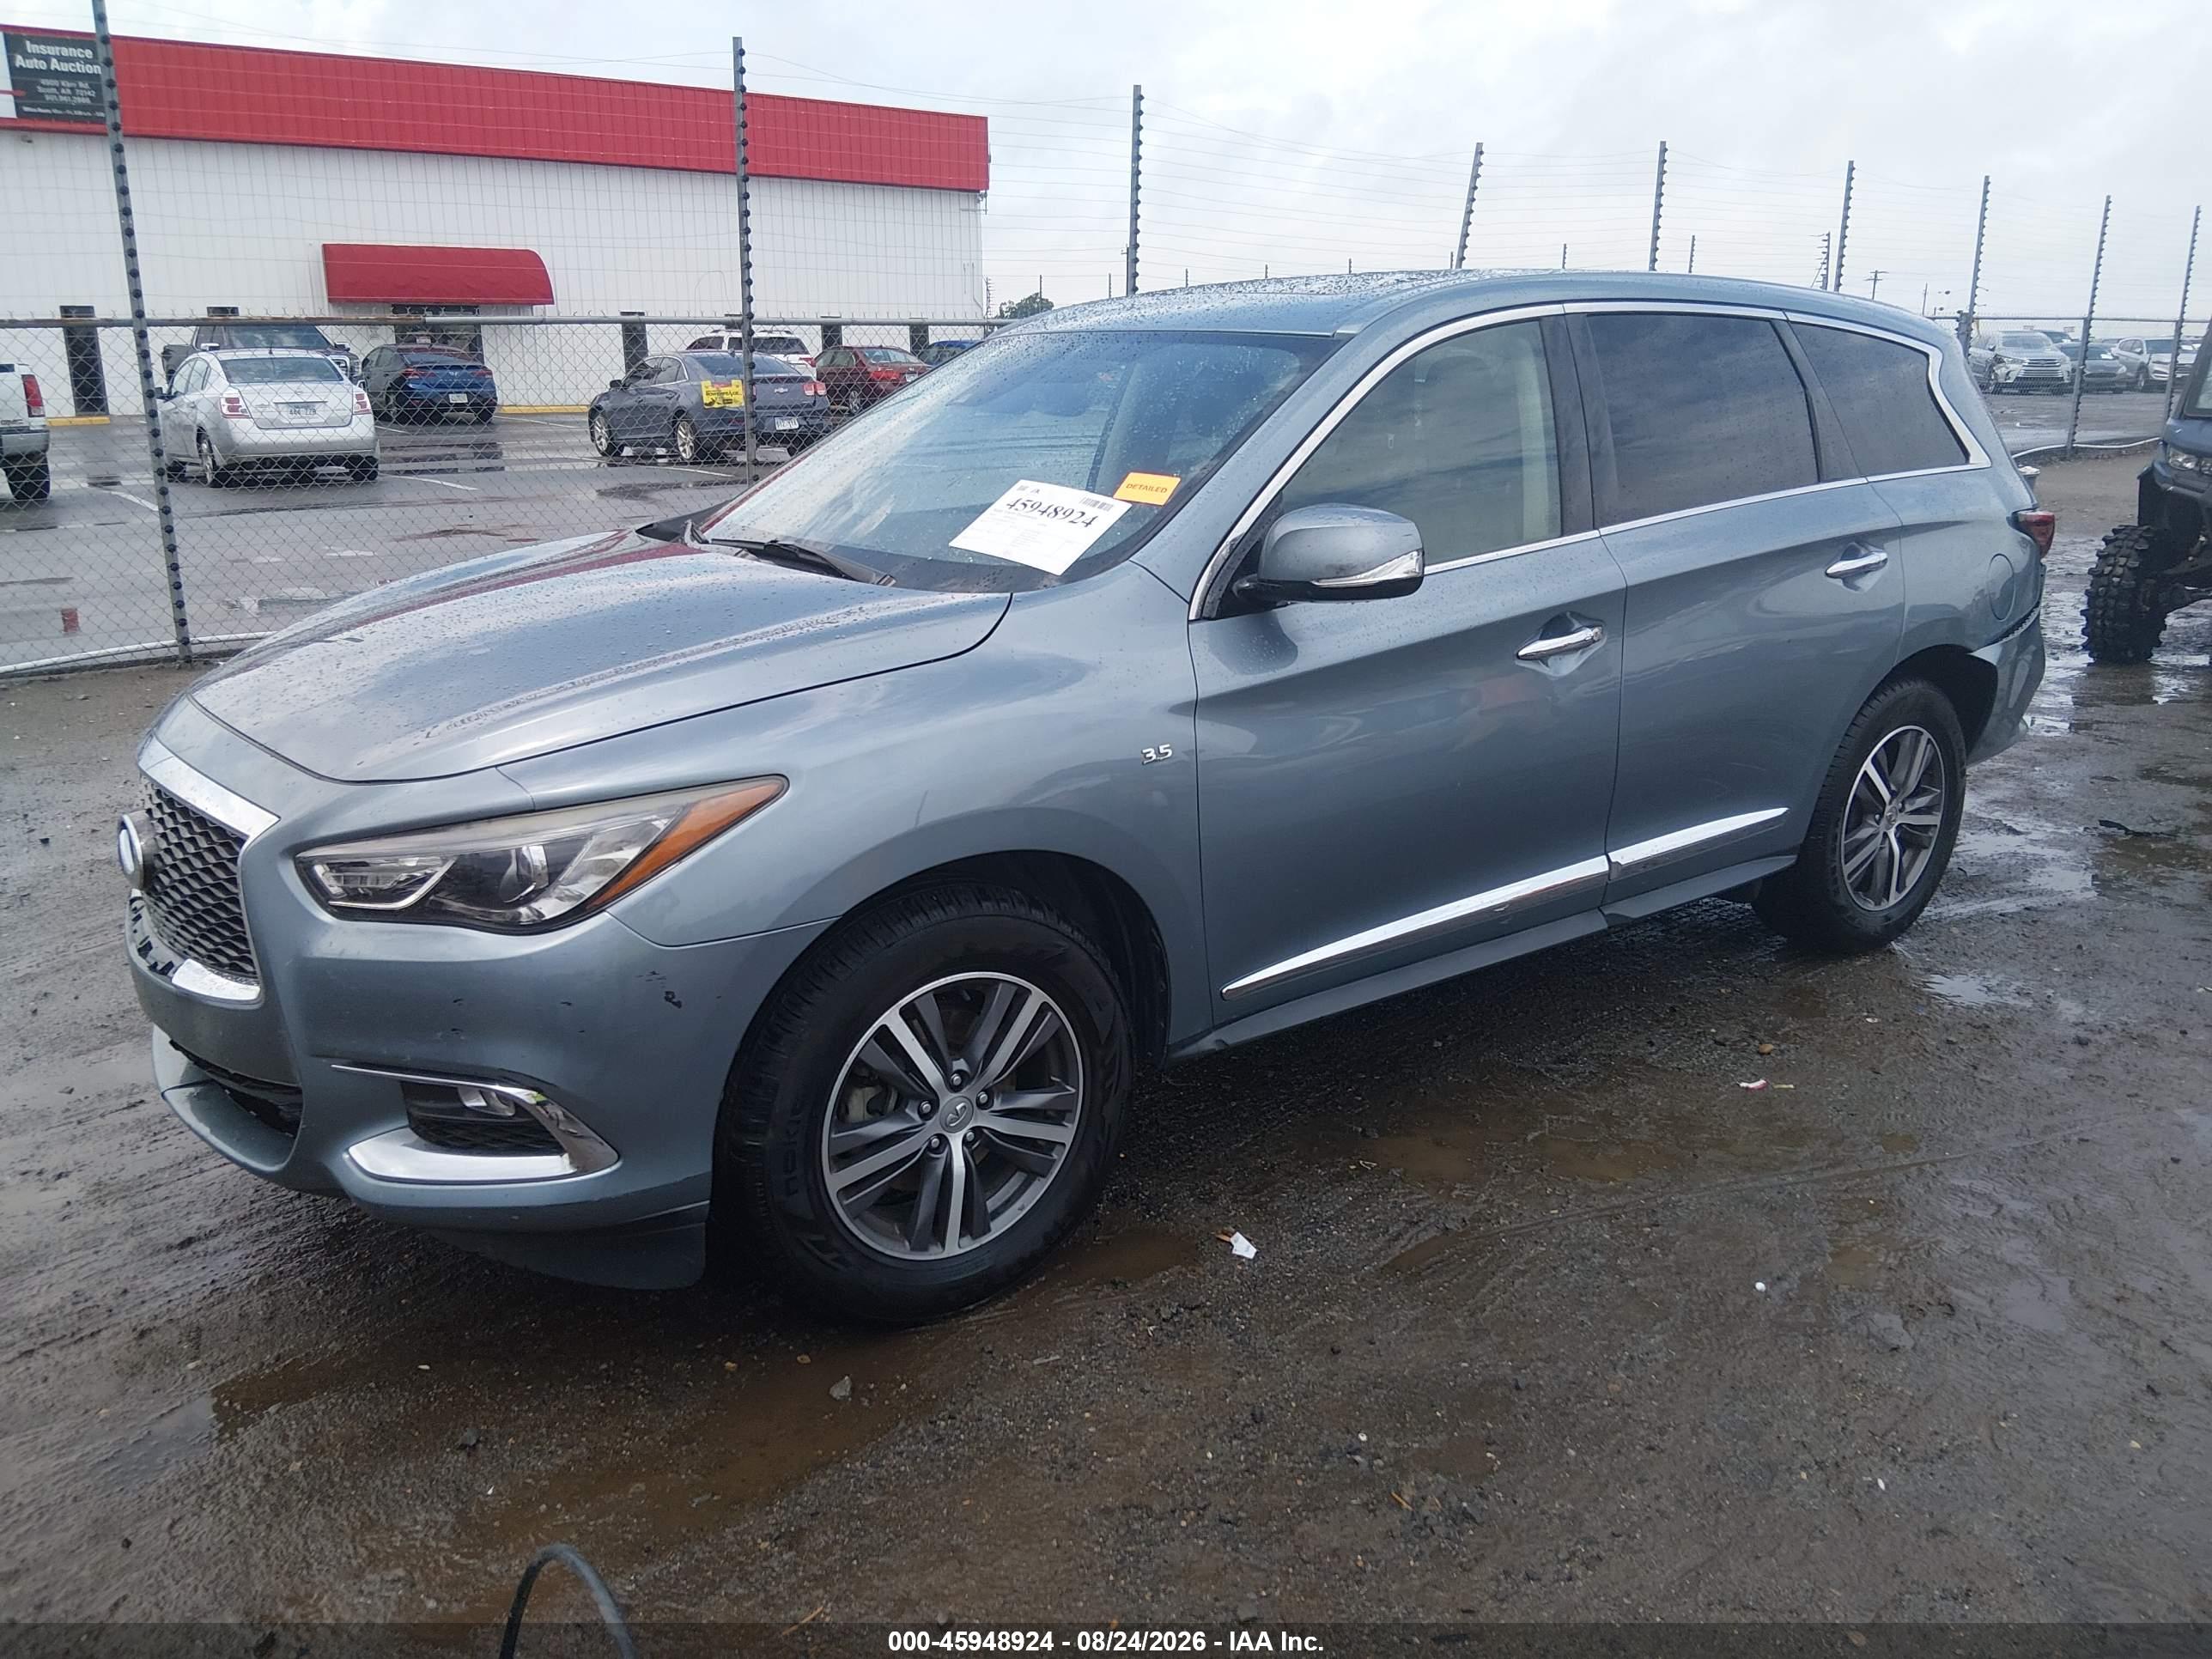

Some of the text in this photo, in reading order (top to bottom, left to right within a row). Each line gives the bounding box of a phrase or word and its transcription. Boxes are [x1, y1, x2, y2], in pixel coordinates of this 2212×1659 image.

[26, 40, 93, 58] Insurance
[15, 54, 101, 75] Auto Auction
[1126, 483, 1168, 494] DETAILED
[1006, 497, 1099, 528] 45948924
